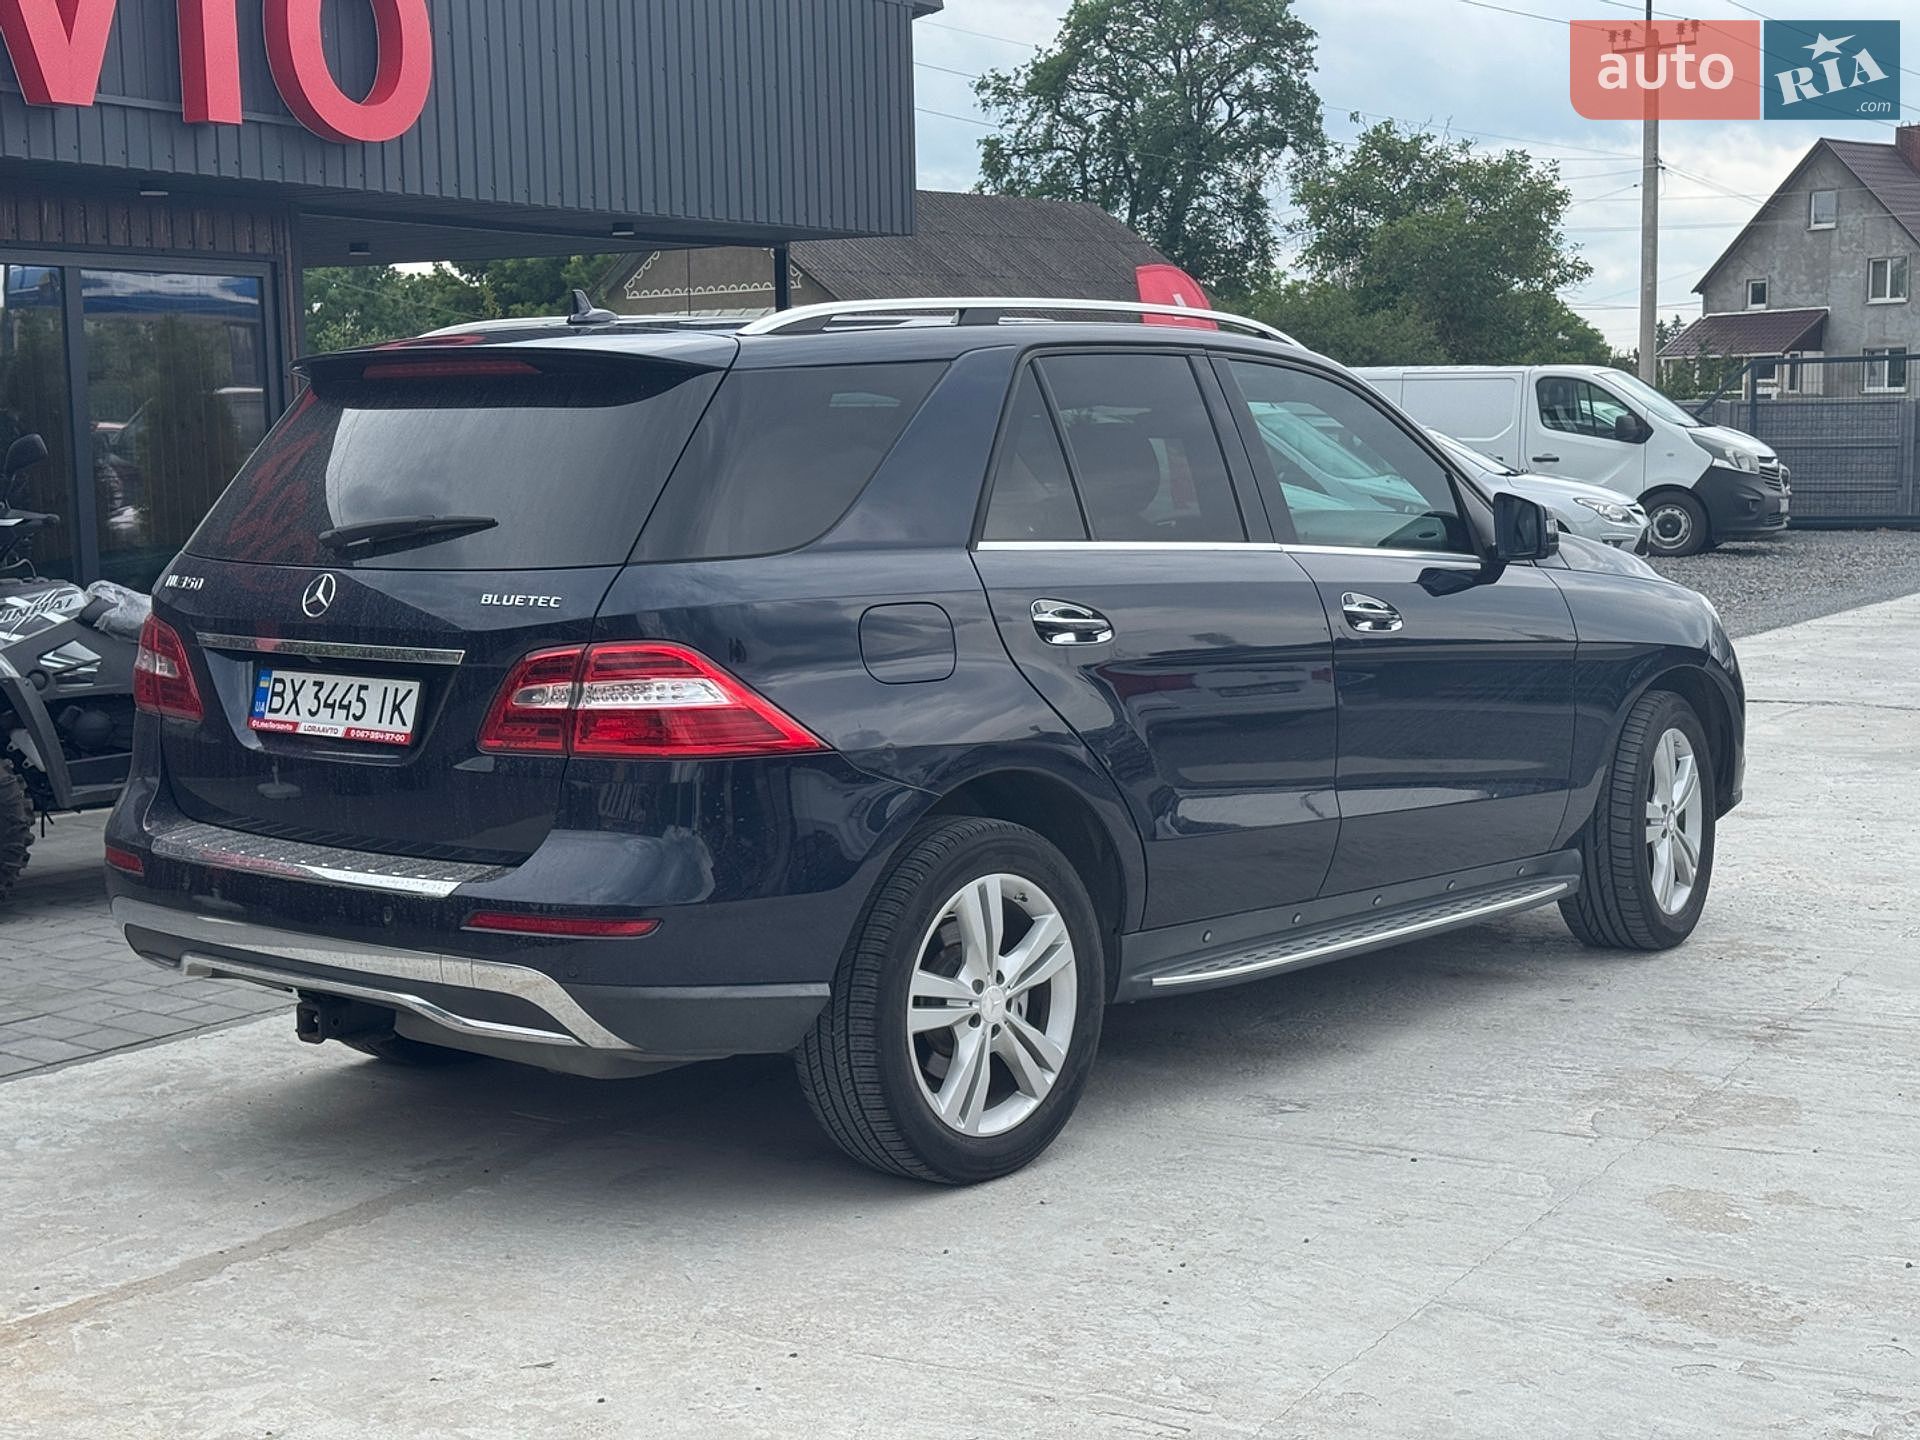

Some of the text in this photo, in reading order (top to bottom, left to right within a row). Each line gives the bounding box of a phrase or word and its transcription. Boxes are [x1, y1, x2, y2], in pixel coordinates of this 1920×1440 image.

[481, 593, 562, 608] BLUETEC
[255, 701, 265, 713] UA
[268, 677, 414, 727] BX 3445 IK
